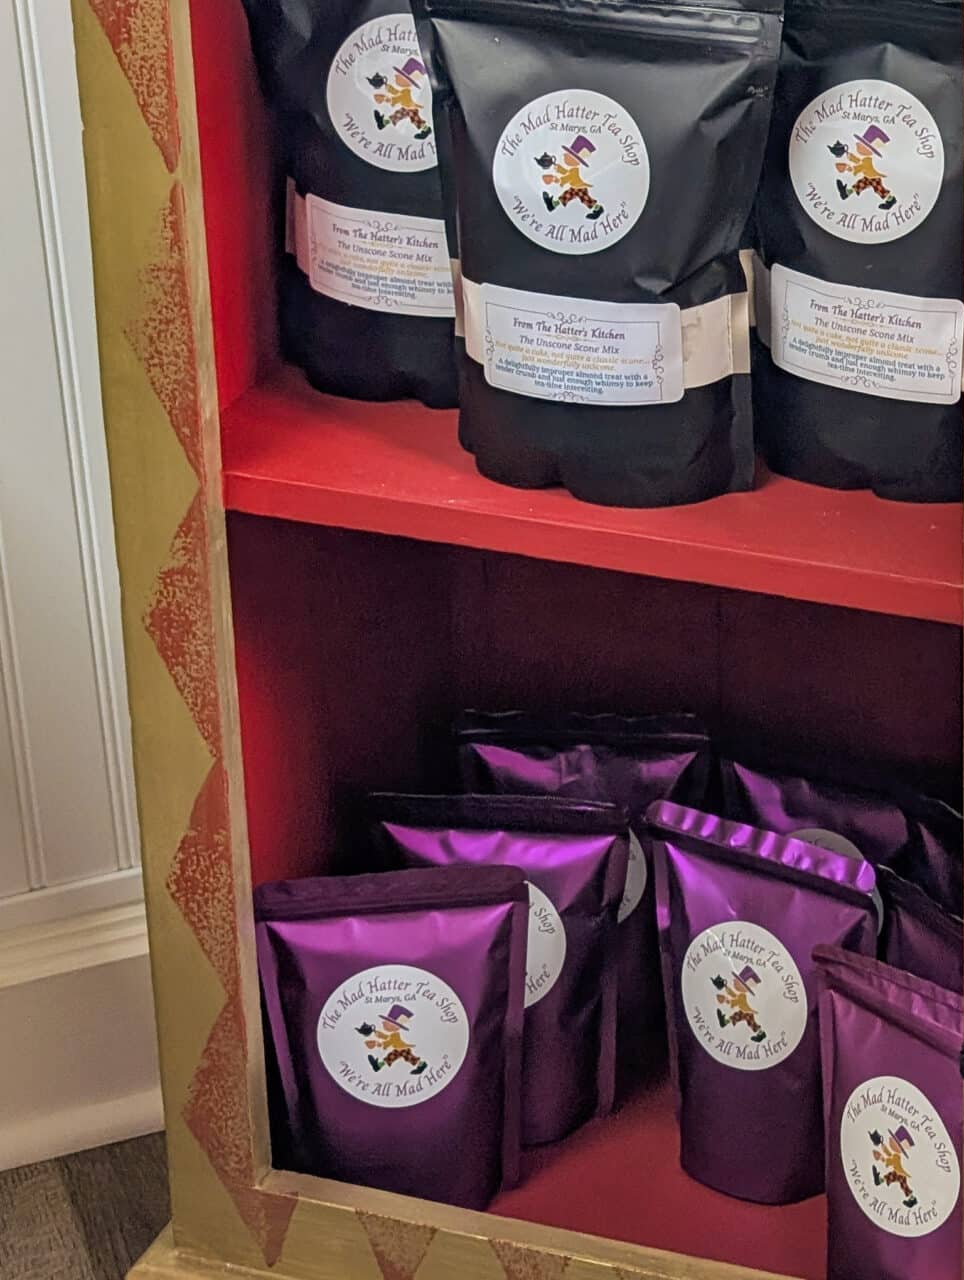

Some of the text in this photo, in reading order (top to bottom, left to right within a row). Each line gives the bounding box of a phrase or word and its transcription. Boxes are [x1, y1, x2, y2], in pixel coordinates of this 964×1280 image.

[335, 24, 417, 76] The Mad Hatt
[380, 44, 389, 52] St
[550, 122, 558, 130] St
[590, 125, 602, 133] GA
[796, 88, 935, 159] The Mad Hatter Tea Shop
[841, 111, 850, 120] St
[882, 115, 896, 124] GA
[501, 100, 641, 167] The Mad Hatter Tea Shop
[373, 143, 396, 159] All
[397, 142, 425, 161] Mad
[836, 213, 858, 229] All
[861, 214, 889, 232] Mad
[545, 225, 566, 241] All
[569, 225, 598, 243] Mad
[809, 298, 922, 329] From The Hatter's Kitchen
[513, 317, 625, 340] From The Hatter's Kitchen
[815, 317, 914, 343] The Unscone Scone Mix
[520, 335, 620, 354] The Unscone Scone Mix
[534, 908, 555, 934] Shop
[686, 951, 702, 972] The
[729, 930, 766, 954] Hatter
[767, 950, 784, 973] Tea
[781, 974, 800, 1003] Shop
[755, 958, 767, 968] GA
[323, 976, 459, 1029] The Mad Hatter Tea Shop
[364, 995, 373, 1003] St
[716, 1040, 733, 1055] All
[735, 1045, 760, 1060] Mad
[371, 1083, 391, 1096] All
[394, 1081, 423, 1097] Mad
[847, 1085, 951, 1173] The Mad Hatter Tea Shop
[910, 1120, 920, 1131] GA
[870, 1197, 887, 1216] All
[888, 1207, 911, 1226] Mad
